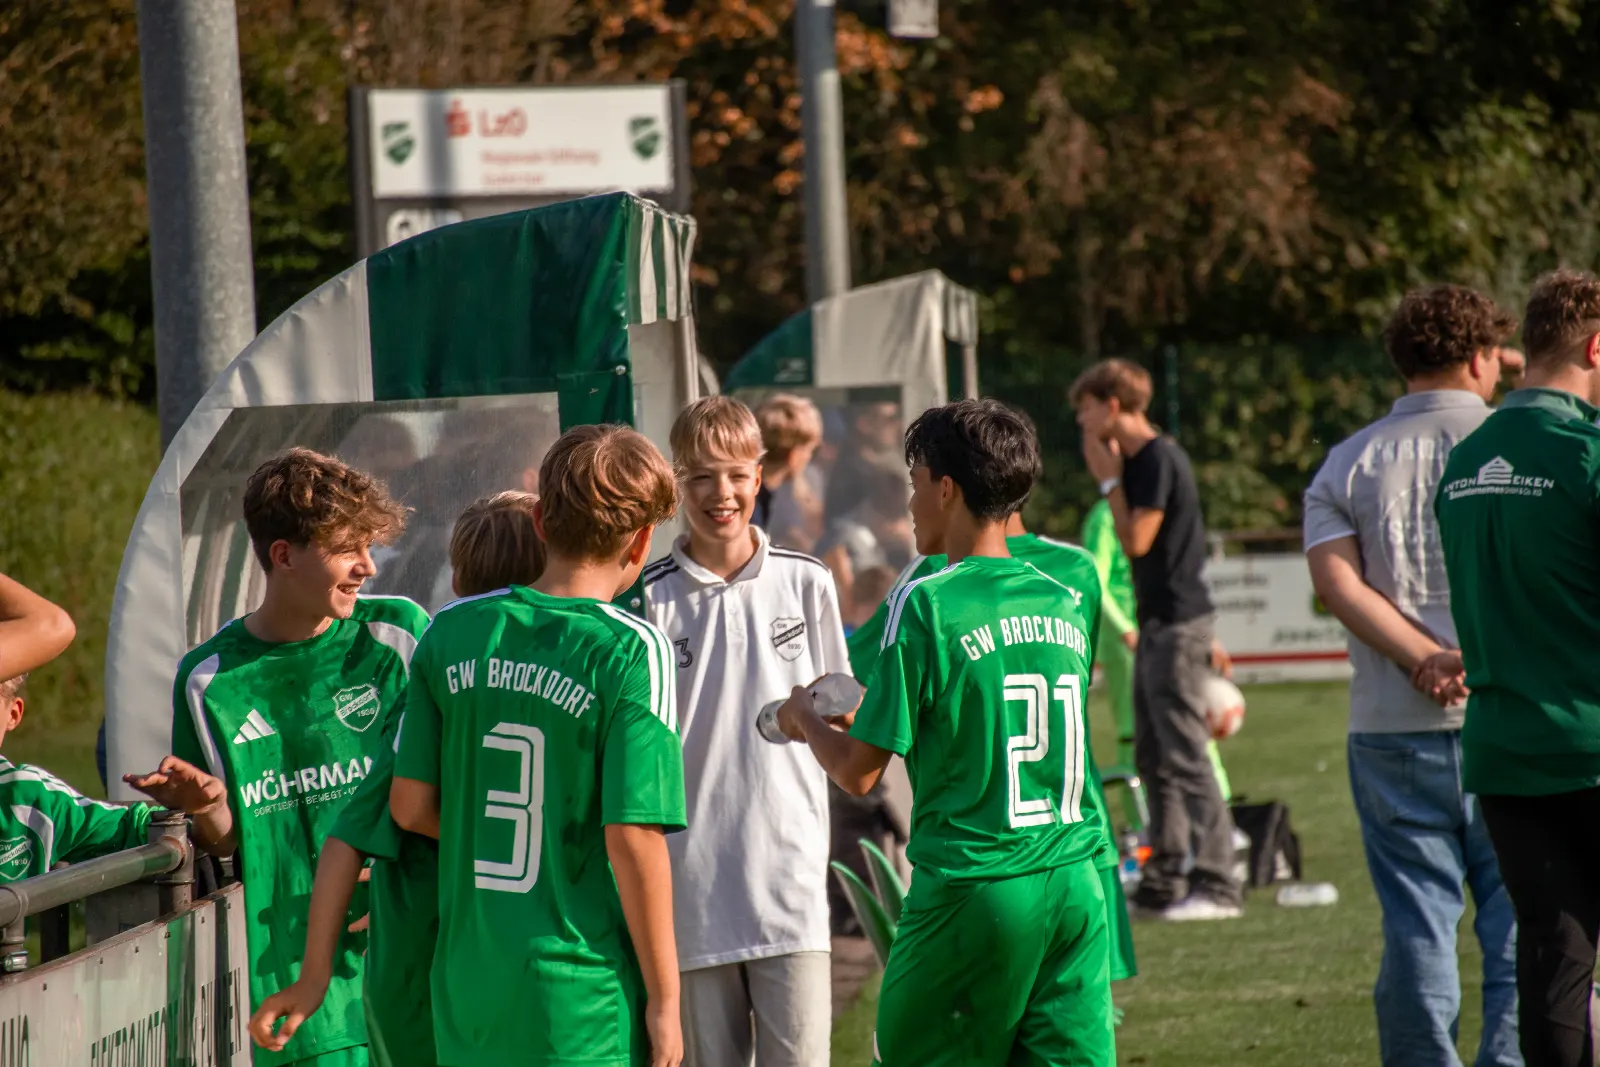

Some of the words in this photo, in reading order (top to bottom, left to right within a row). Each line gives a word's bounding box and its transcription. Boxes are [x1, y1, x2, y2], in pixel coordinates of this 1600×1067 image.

[674, 637, 693, 668] 3
[960, 624, 995, 661] GW
[446, 658, 476, 695] GW
[487, 657, 596, 719] BROCKDORF
[1003, 673, 1085, 829] 21
[474, 721, 545, 893] 3
